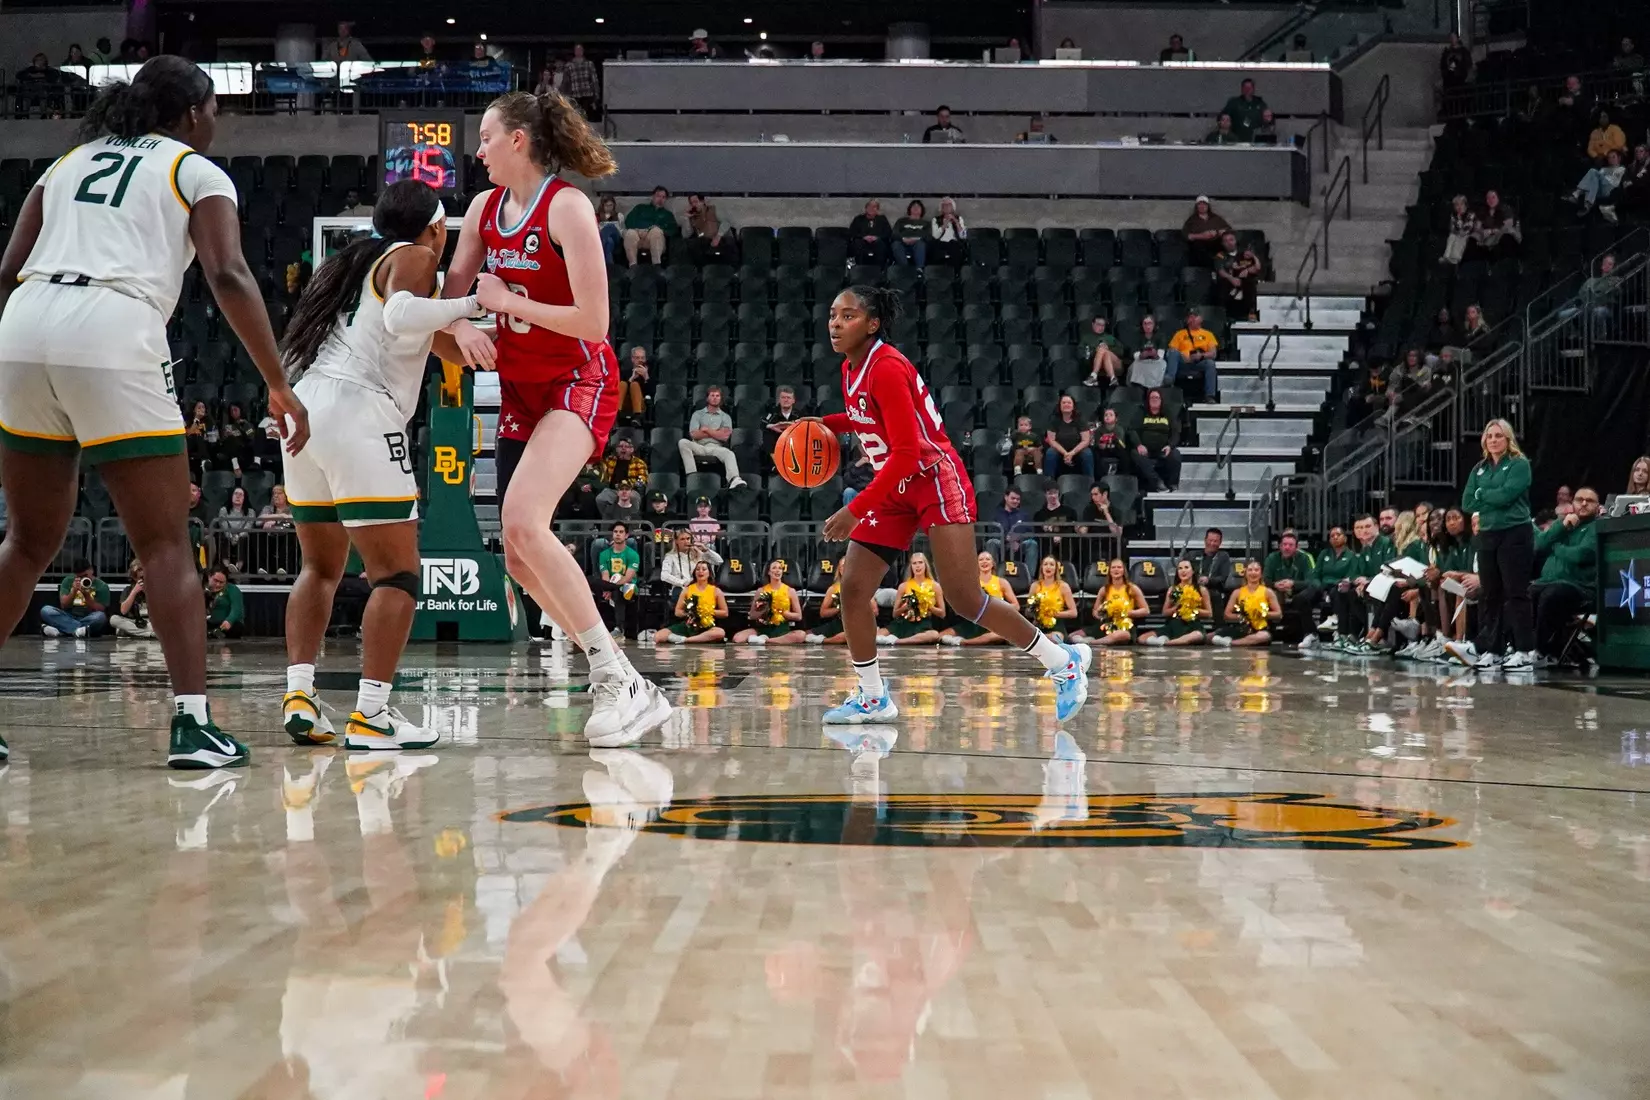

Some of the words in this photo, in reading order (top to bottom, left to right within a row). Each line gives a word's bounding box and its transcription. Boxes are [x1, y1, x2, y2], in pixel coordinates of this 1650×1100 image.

[407, 123, 451, 146] 7:58
[413, 147, 444, 190] 15
[74, 151, 144, 208] 21
[434, 446, 466, 484] BU
[730, 559, 742, 573] BU
[821, 560, 833, 574] BU
[1005, 561, 1018, 575] BU
[1143, 561, 1155, 576] BU
[427, 599, 456, 610] Bank
[458, 599, 475, 611] for
[476, 599, 498, 611] Life
